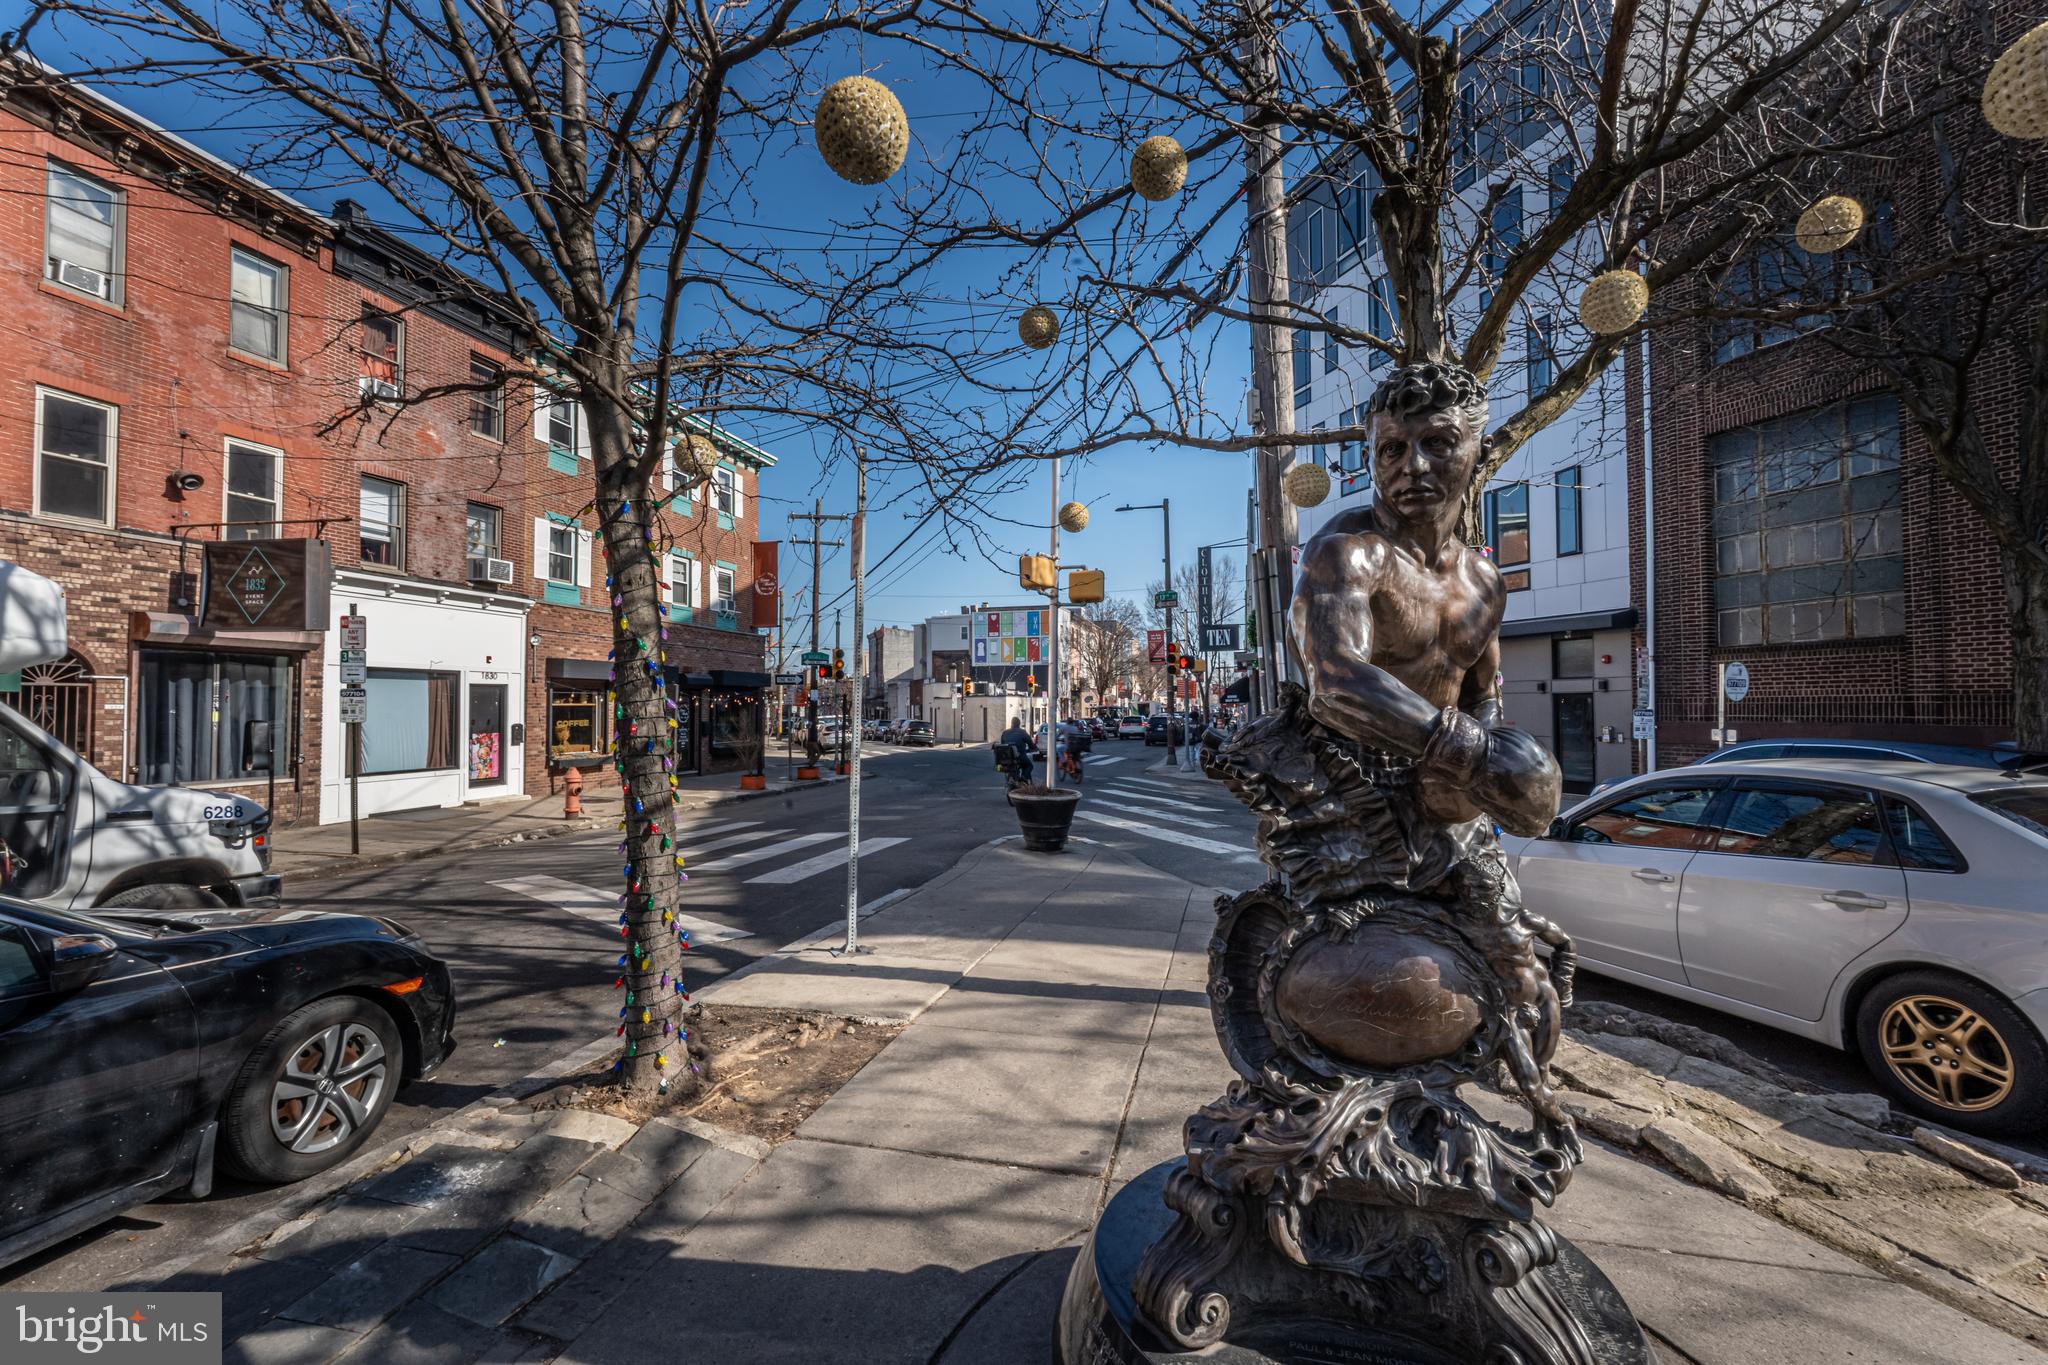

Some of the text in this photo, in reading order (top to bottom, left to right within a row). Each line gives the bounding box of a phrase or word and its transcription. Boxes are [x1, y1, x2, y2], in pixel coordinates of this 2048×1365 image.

[245, 578, 266, 591] 1832
[1201, 549, 1209, 625] CLOTHING
[1206, 629, 1231, 646] TEN
[342, 652, 348, 662] 3
[481, 671, 498, 680] 1830
[556, 719, 590, 727] COFFEE
[203, 805, 244, 820] 6288
[1288, 1340, 1322, 1354] PAUL
[1337, 1348, 1373, 1362] JEAN
